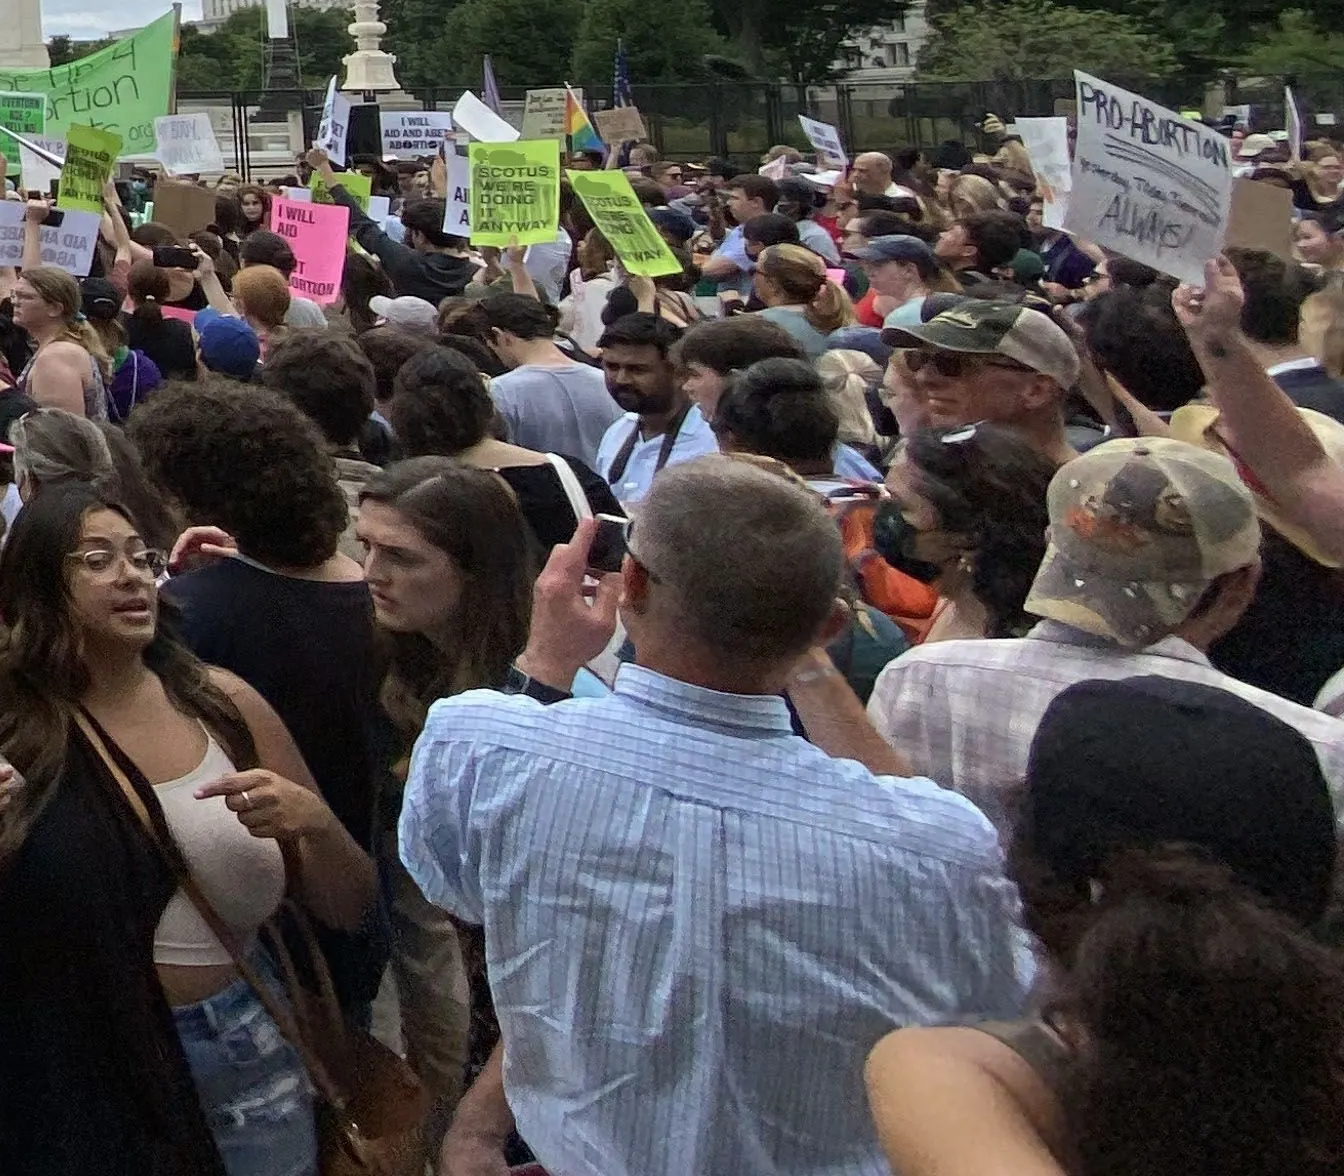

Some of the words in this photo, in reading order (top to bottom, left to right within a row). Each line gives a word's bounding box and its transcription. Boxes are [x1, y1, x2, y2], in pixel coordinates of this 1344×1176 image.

[406, 116, 429, 127] WILL
[384, 129, 401, 138] AID
[402, 129, 423, 138] AND
[478, 166, 549, 178] SCOTUS
[480, 194, 535, 205] DOING
[285, 206, 316, 225] WILL
[480, 207, 497, 218] IT
[277, 222, 298, 238] AID
[478, 219, 548, 233] ANYWAY
